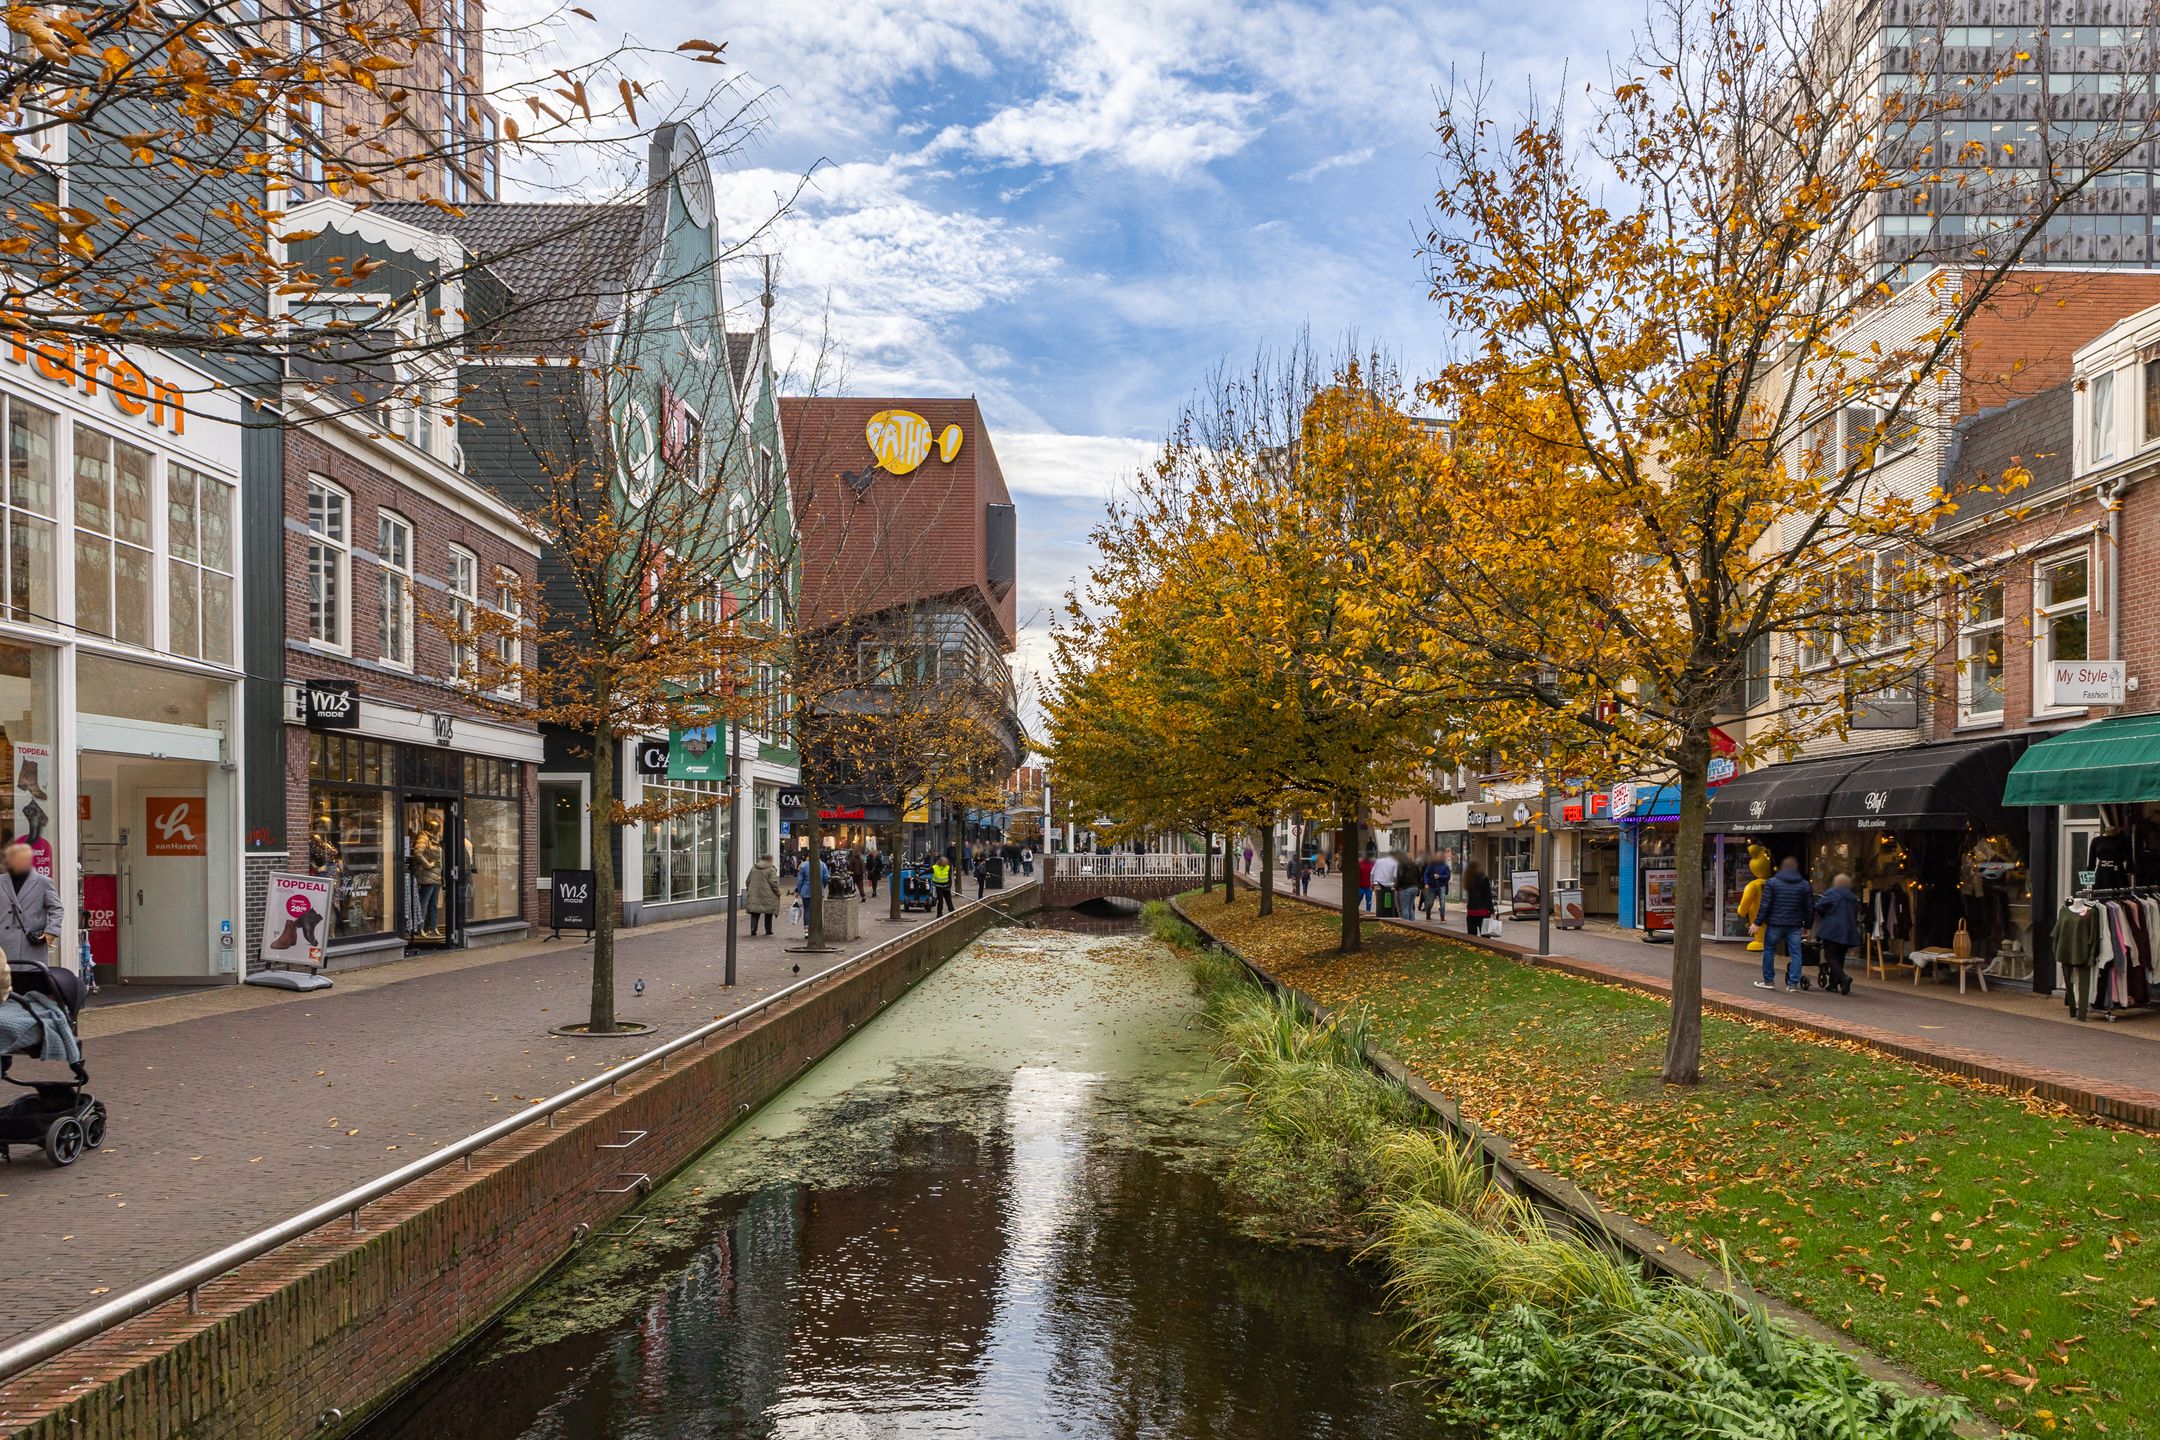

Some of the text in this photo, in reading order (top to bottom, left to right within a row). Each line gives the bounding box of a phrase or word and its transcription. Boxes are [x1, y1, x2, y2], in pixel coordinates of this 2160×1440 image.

[2057, 669, 2108, 685] My Style
[2083, 691, 2109, 699] Fashion
[17, 746, 49, 757] TOPDEAL
[276, 879, 327, 892] TOPDEAL
[89, 910, 114, 920] TOP
